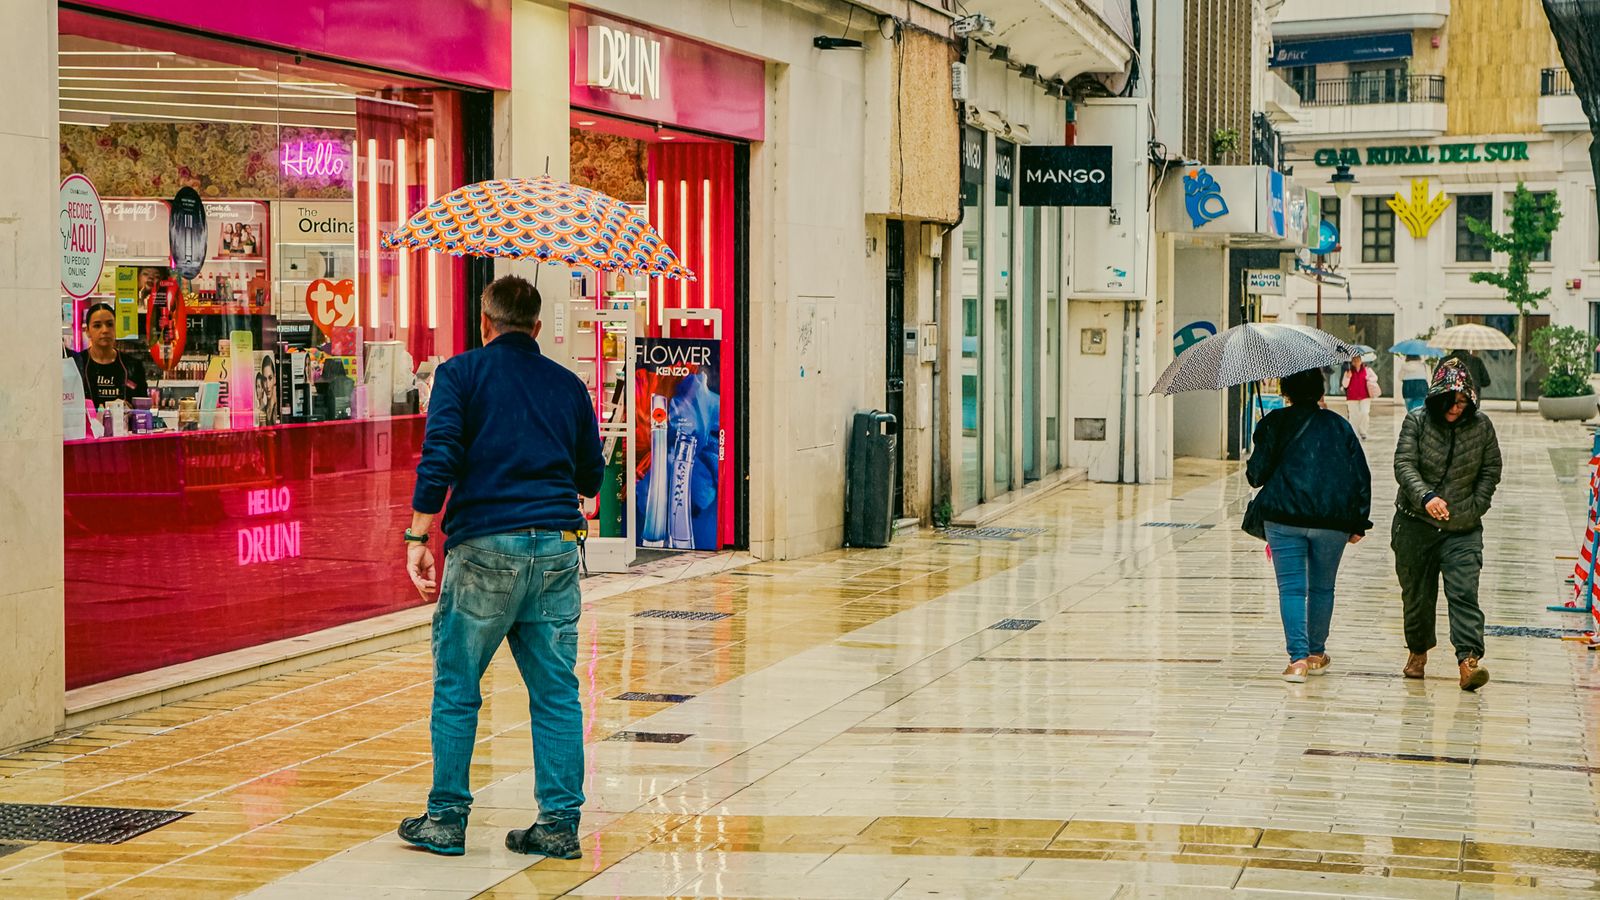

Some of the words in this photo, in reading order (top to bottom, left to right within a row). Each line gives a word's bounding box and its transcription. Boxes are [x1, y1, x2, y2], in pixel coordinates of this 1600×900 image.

[598, 26, 661, 100] DRUNI
[281, 142, 344, 175] Hello
[1366, 144, 1434, 165] RURAL
[1438, 143, 1481, 163] DEL
[1484, 141, 1529, 161] SUR
[1026, 169, 1105, 184] MANGO
[68, 202, 92, 219] RECOGE
[298, 207, 318, 217] The
[71, 218, 97, 253] AQUÍ
[64, 256, 71, 264] TU
[72, 256, 90, 266] PEDIDO
[68, 267, 87, 277] ONLINE
[636, 345, 711, 366] FLOWER
[656, 366, 690, 377] KENZO
[248, 486, 291, 515] HELLO
[238, 521, 301, 566] DRUNI
